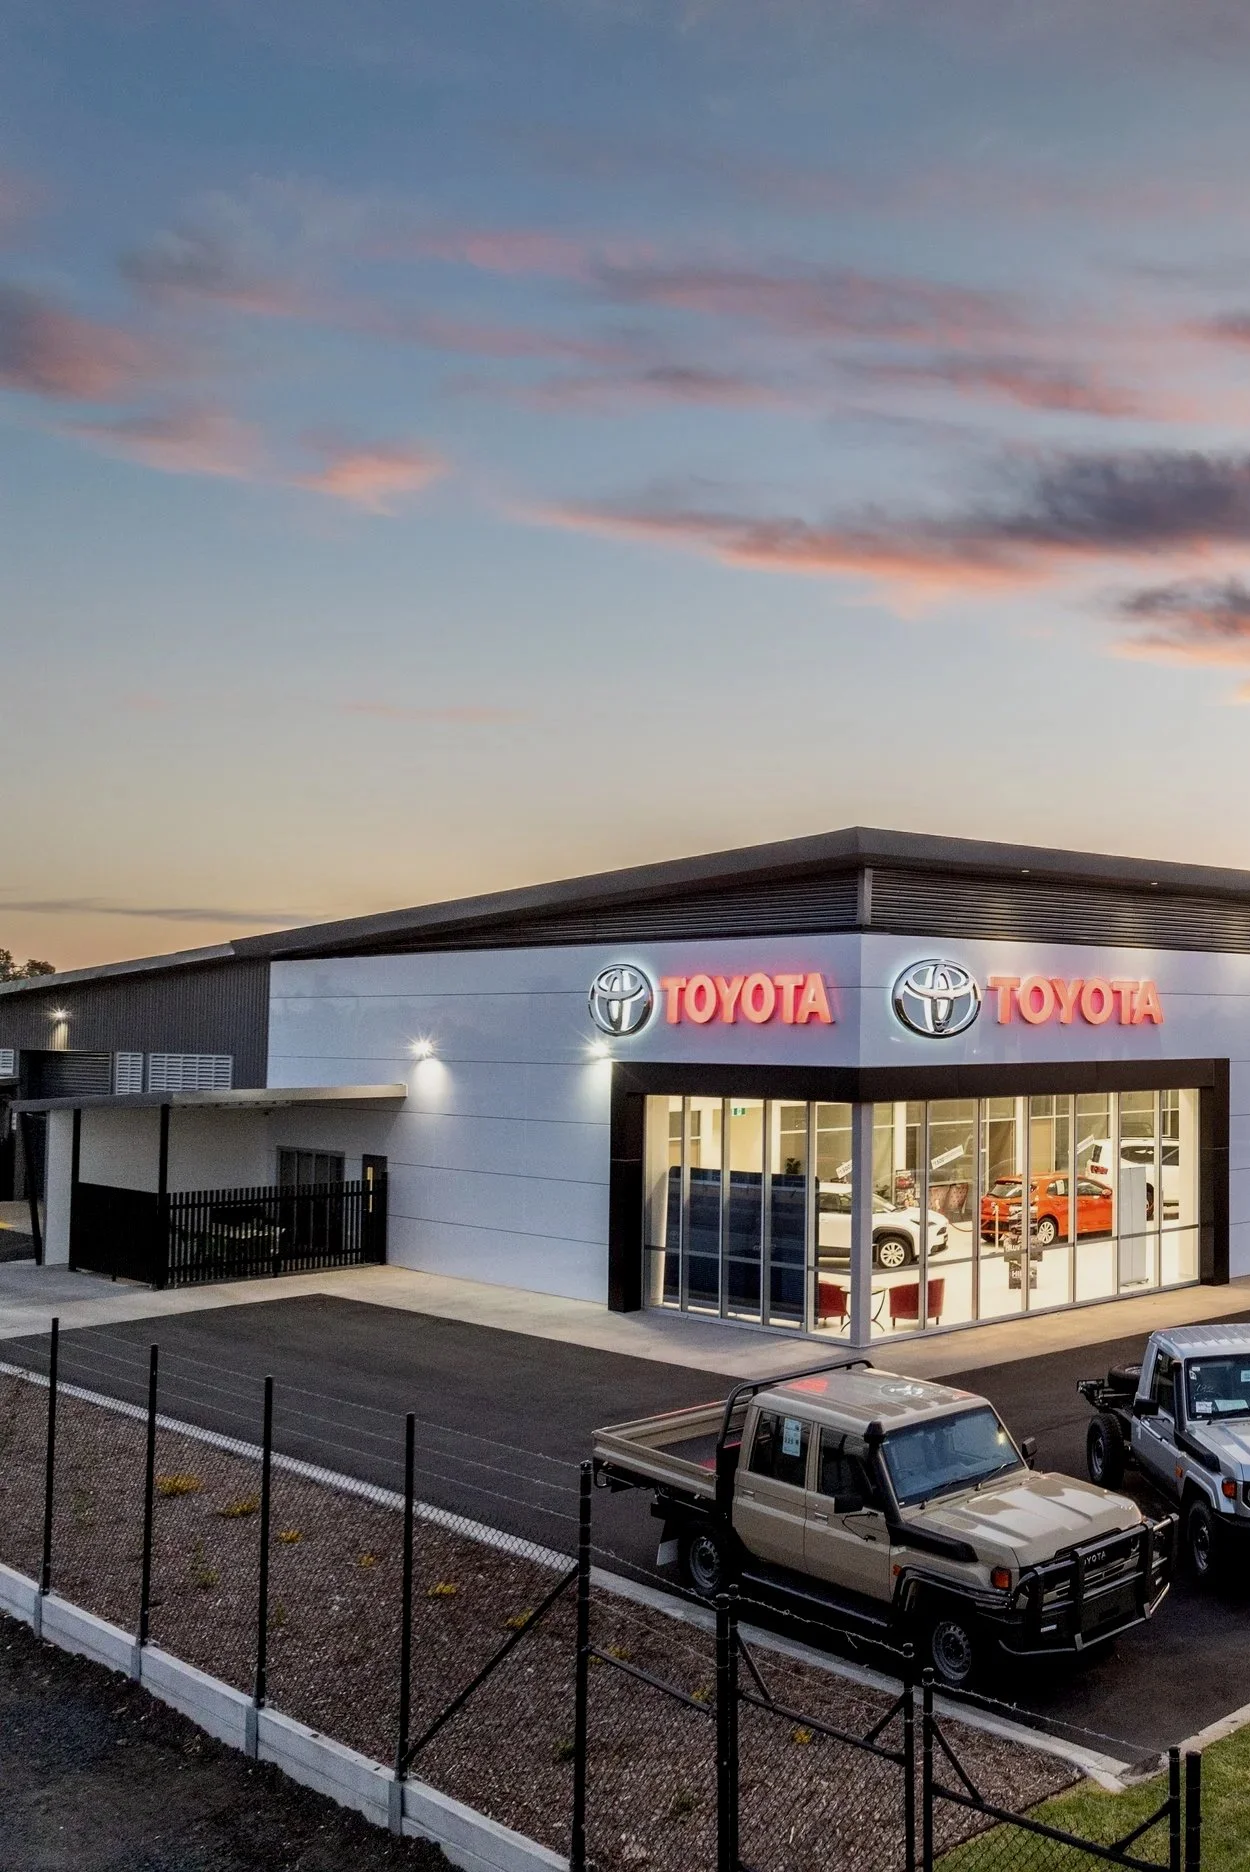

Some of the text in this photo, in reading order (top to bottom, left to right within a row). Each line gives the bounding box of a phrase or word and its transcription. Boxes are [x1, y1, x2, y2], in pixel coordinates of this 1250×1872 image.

[661, 973, 833, 1024] TOYOTA
[987, 975, 1164, 1024] TOYOTA
[1084, 1551, 1106, 1565] YOTA
